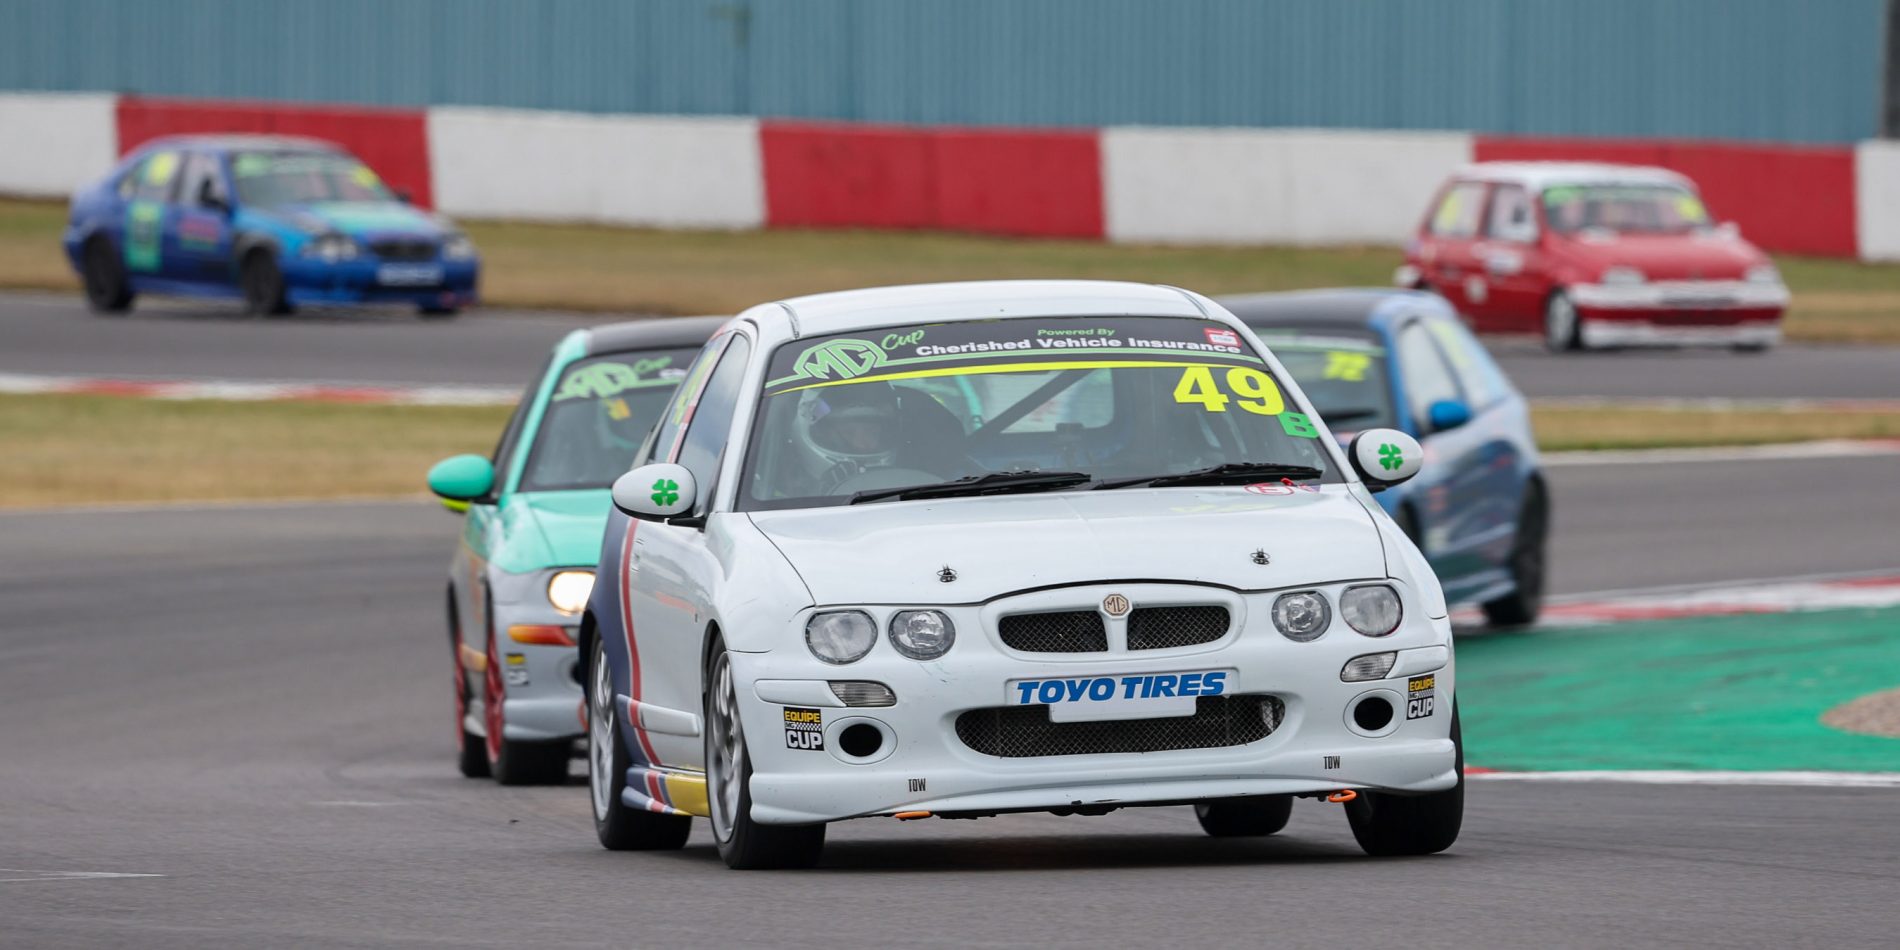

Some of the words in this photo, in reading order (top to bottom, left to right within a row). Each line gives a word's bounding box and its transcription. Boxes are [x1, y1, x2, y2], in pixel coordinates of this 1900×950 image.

[881, 330, 925, 350] Cup
[1097, 328, 1115, 336] By
[916, 338, 1031, 356] Cherished
[1036, 337, 1122, 349] Vehicle
[1128, 337, 1241, 354] Insurance
[799, 342, 882, 379] MG
[1173, 366, 1285, 416] 49
[1276, 411, 1320, 438] B
[1017, 678, 1116, 704] TOYO
[1121, 672, 1227, 699] TIRES
[1409, 677, 1435, 691] EQUIPE
[784, 710, 821, 723] EQUIPE
[1408, 697, 1434, 719] CUP
[786, 731, 823, 749] CUP
[1323, 755, 1341, 770] TOW
[908, 778, 926, 792] TOW
